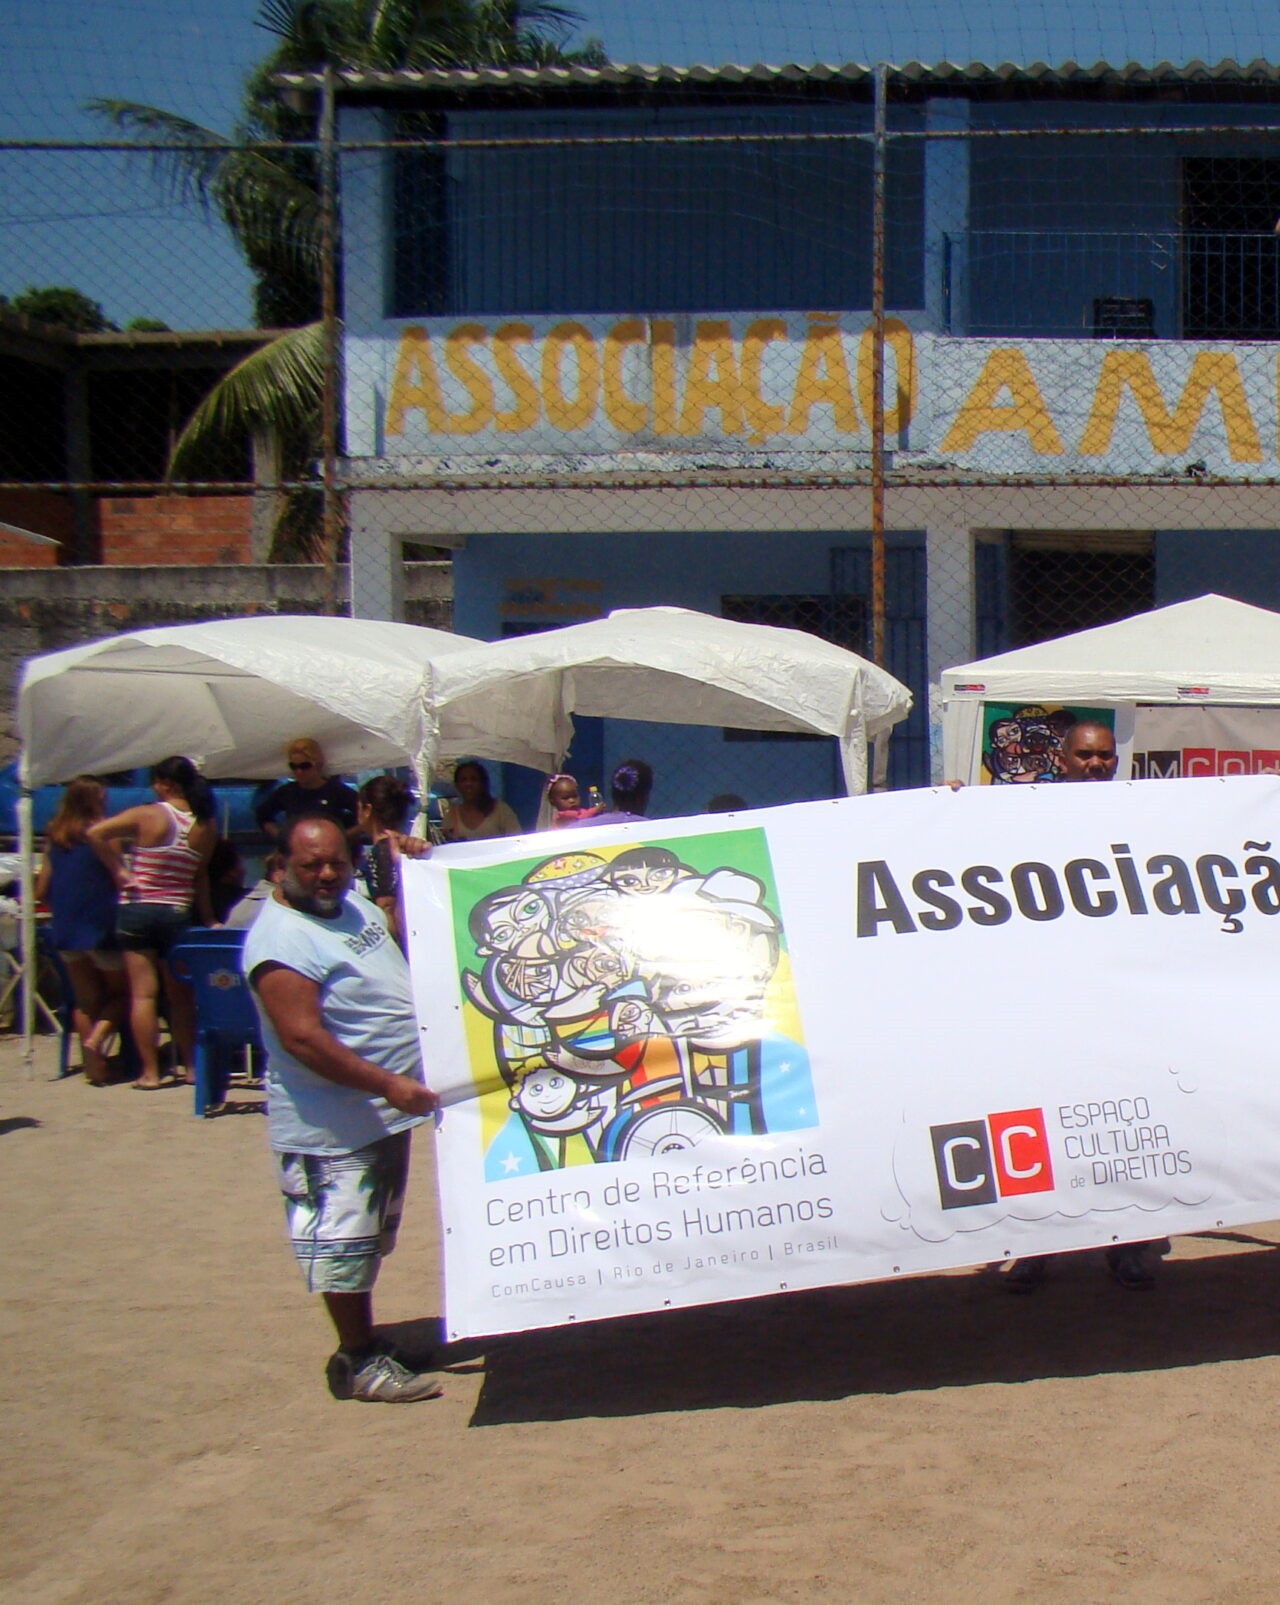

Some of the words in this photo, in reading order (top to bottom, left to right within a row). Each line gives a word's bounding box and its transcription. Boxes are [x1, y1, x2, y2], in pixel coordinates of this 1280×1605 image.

[384, 311, 917, 446] ASSOCIAÇÃO
[1058, 1096, 1151, 1130] ESPAÇO
[1063, 1123, 1171, 1160] CULTURA
[485, 1187, 591, 1227] Centro
[603, 1177, 641, 1207] de
[652, 1146, 828, 1199] Referência
[1069, 1175, 1086, 1190] de
[1091, 1149, 1193, 1187] DIREITOS
[488, 1239, 537, 1268] em
[547, 1219, 673, 1258] Direitos
[682, 1195, 835, 1238] Humanos
[490, 1271, 588, 1299] ComCausa
[612, 1264, 644, 1280] Rio
[652, 1259, 674, 1275] de
[682, 1249, 760, 1271] Janeiro
[783, 1235, 840, 1257] Brasil
